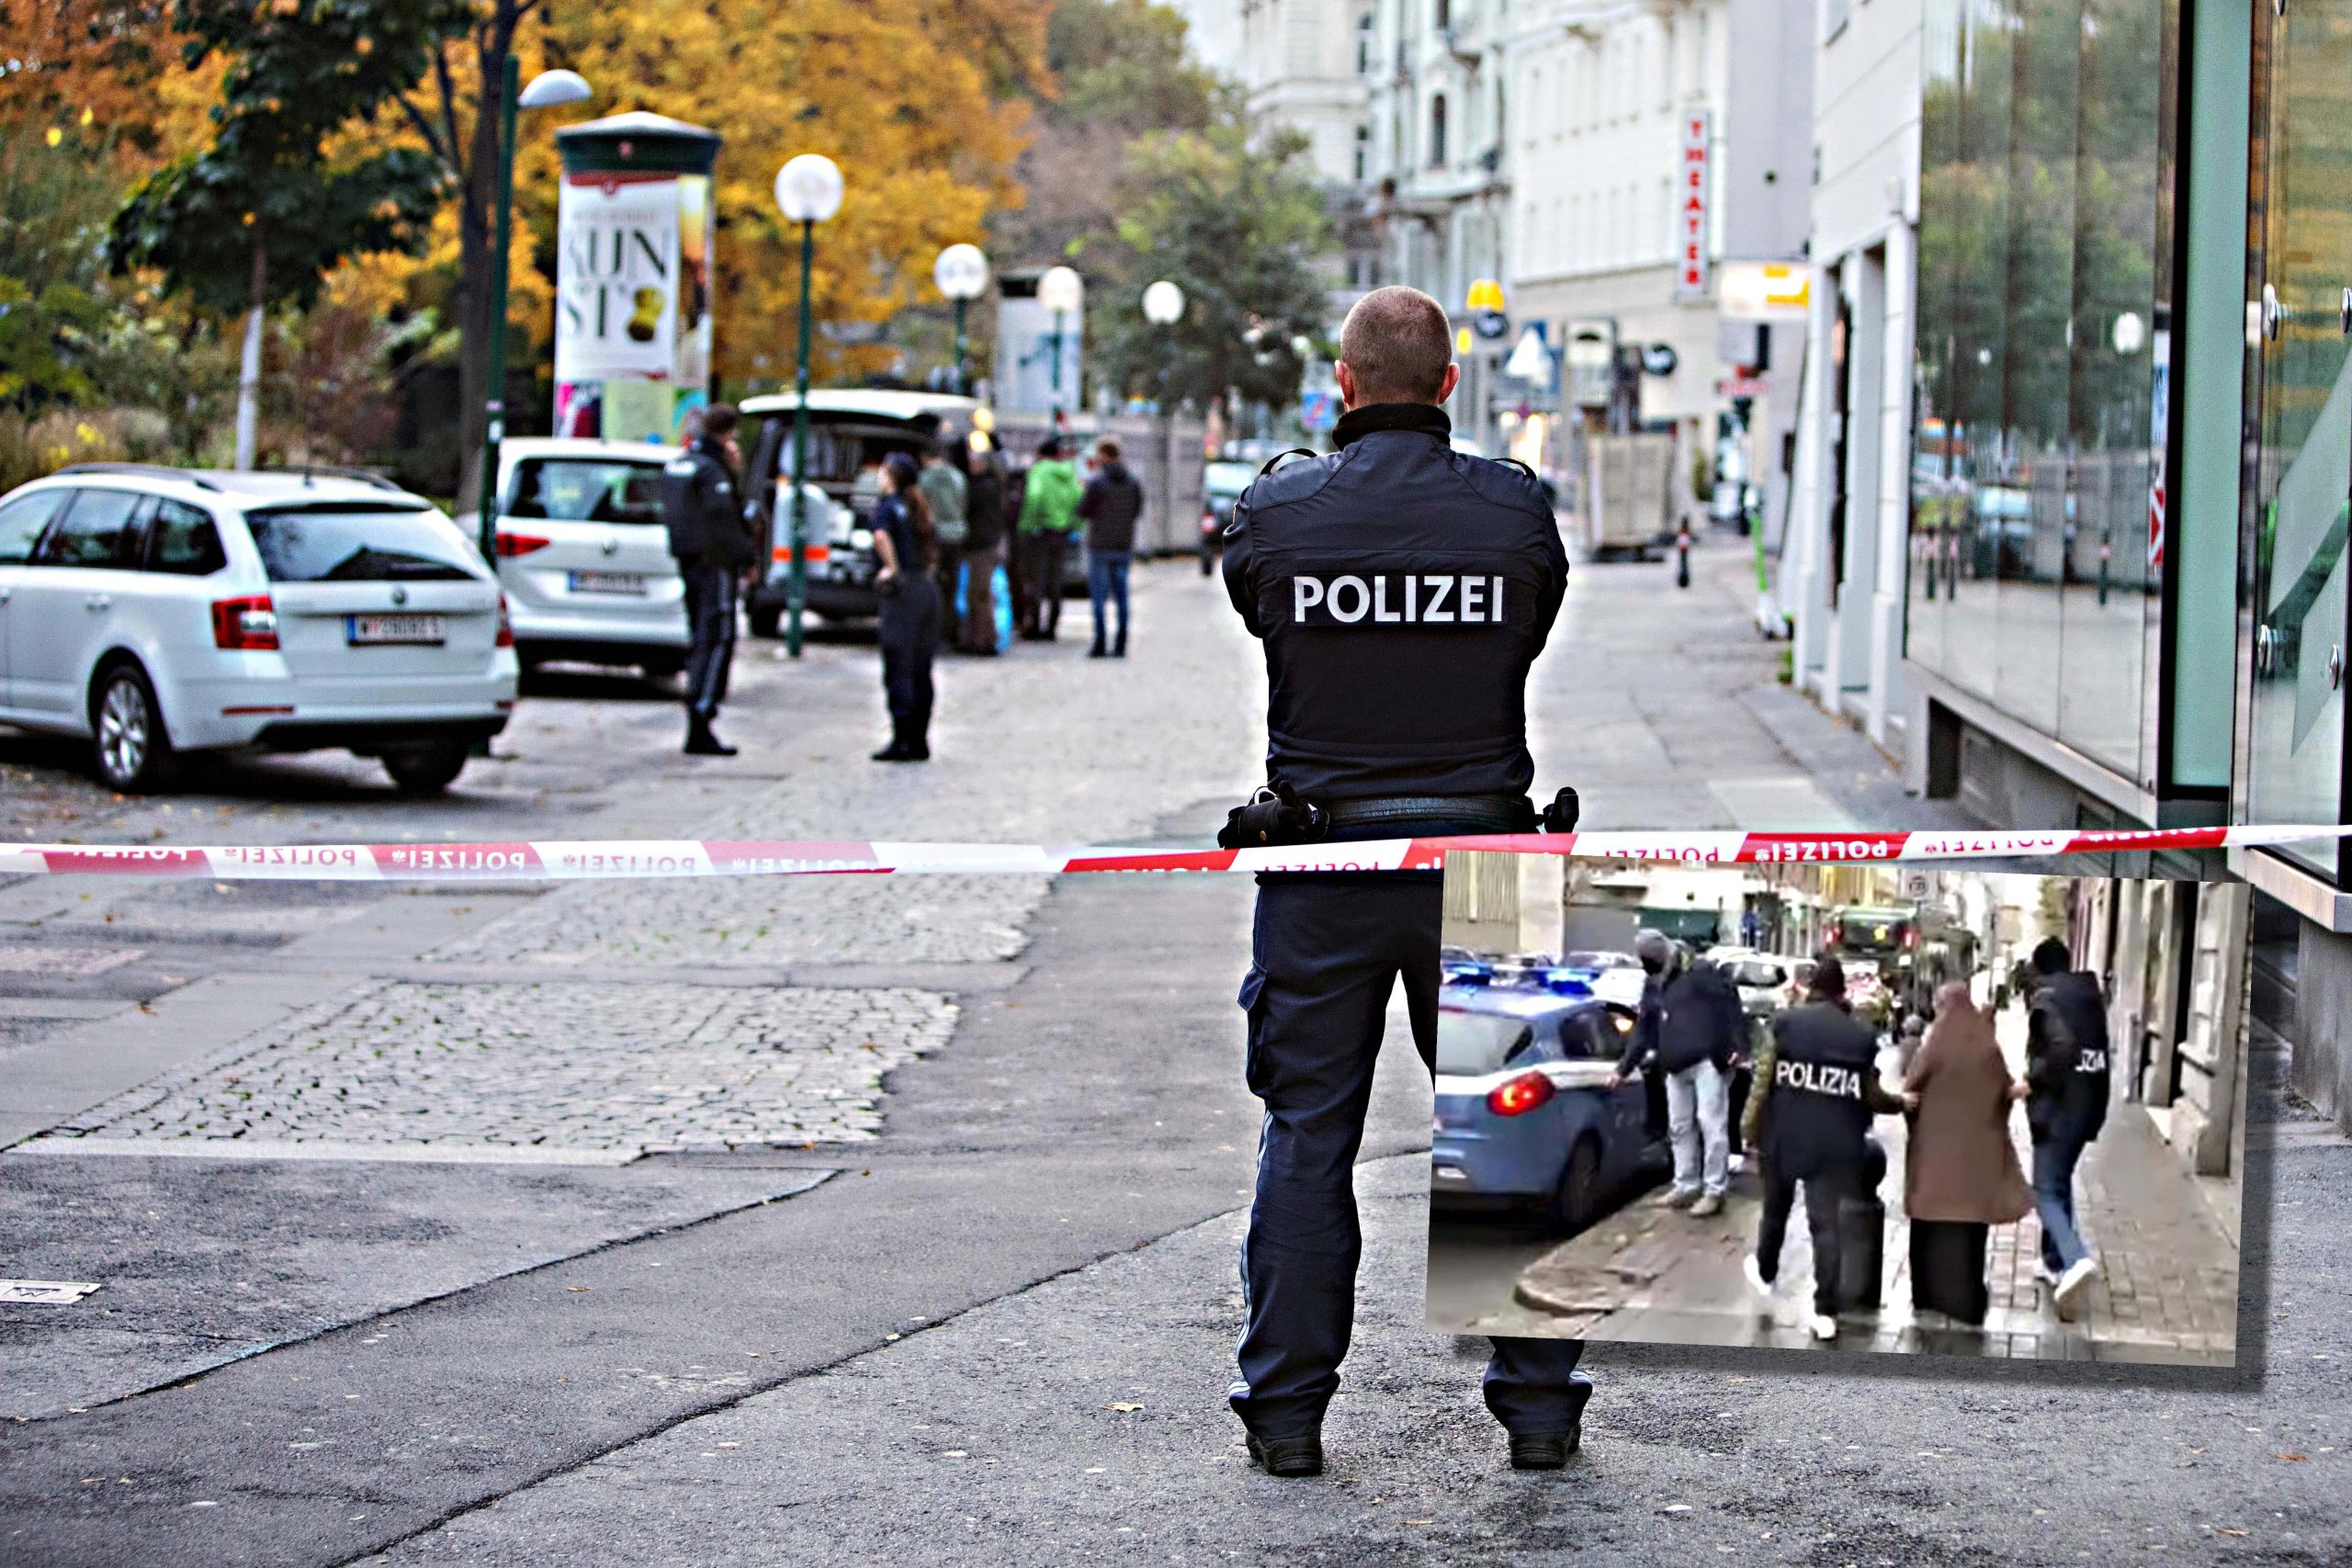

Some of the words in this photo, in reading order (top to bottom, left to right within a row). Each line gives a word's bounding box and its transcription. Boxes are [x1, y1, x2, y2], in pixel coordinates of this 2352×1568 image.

[1685, 119, 1706, 286] THEATER
[1294, 575, 1503, 623] POLIZEI
[1771, 840, 1888, 862] POLIZEI
[1776, 1060, 1861, 1100] POLIZIA
